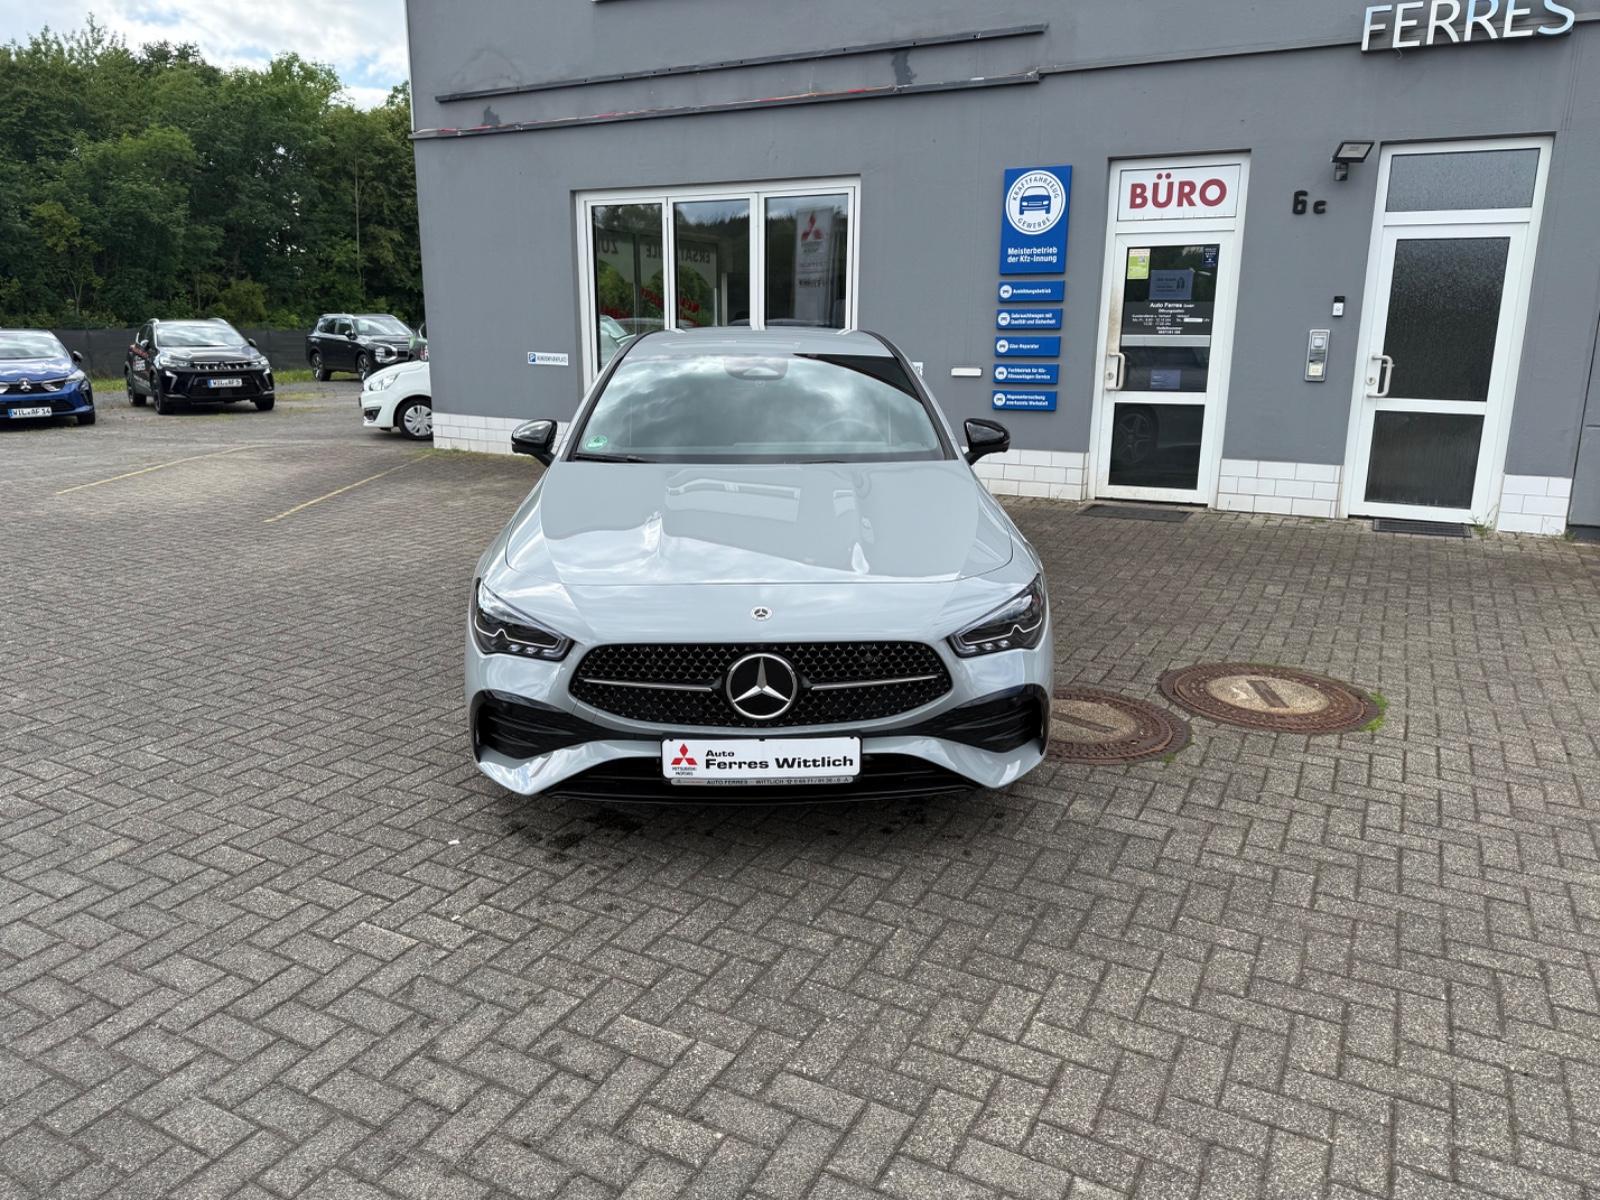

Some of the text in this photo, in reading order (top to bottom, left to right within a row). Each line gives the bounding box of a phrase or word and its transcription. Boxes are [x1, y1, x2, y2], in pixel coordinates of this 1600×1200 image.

[1361, 0, 1576, 50] FERRES
[1012, 176, 1060, 201] KRAFTFAHRZEUG
[1129, 172, 1227, 209] BÜRO
[1017, 216, 1051, 229] GEWERBE
[1007, 246, 1058, 255] Meisterbetrieb
[1020, 255, 1058, 263] Kfz-Innung
[705, 756, 854, 770] Ferres Wittlich
